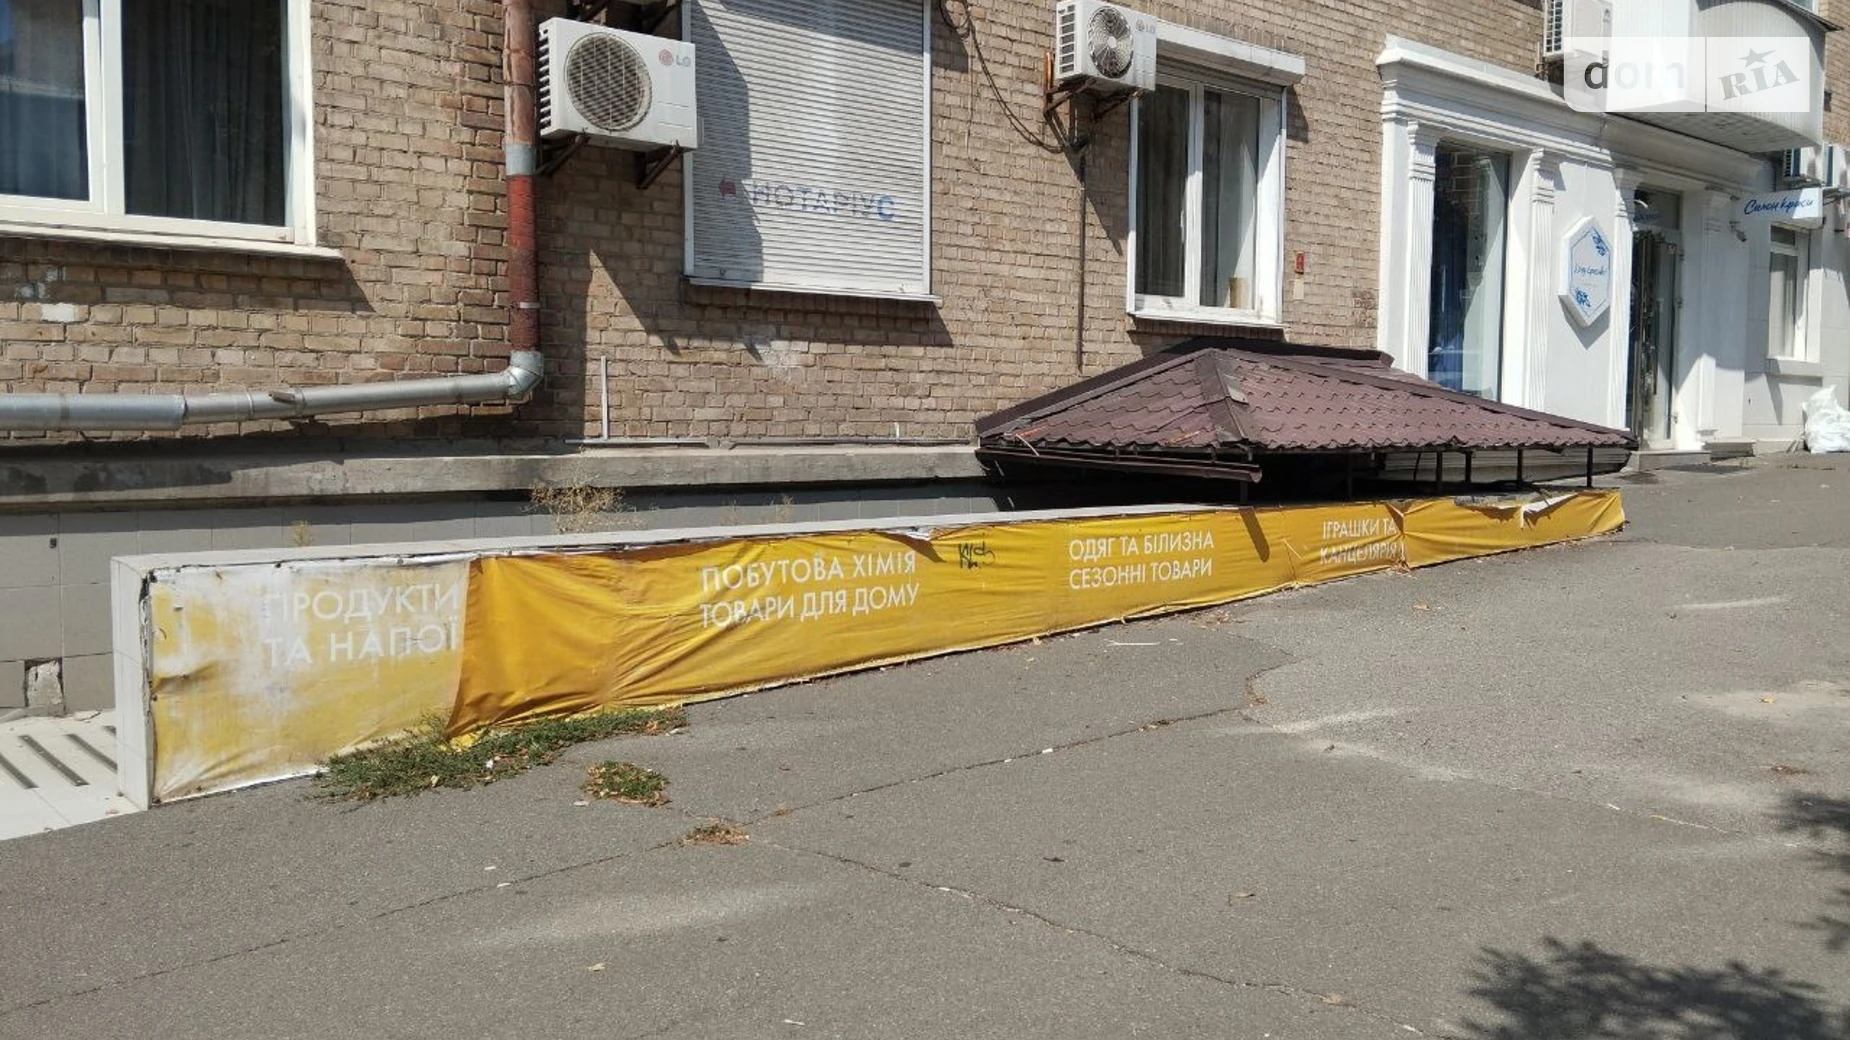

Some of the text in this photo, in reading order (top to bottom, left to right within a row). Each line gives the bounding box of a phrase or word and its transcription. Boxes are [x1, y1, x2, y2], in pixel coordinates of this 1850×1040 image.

[1069, 530, 1214, 563] ОДЯГ ТА БІЛИЗНА
[1323, 517, 1398, 539] ІГРАШКИ ТА
[702, 551, 916, 592] ПОБУТОВА ХІМІЯ
[1069, 558, 1213, 589] СЕЗОННІ ТОВАРИ
[262, 582, 461, 624] ПРОДУКТИ
[701, 582, 920, 628] ТОВАРИ ДЛЯ ДОМУ
[264, 615, 458, 668] ТА НАПОЇ
